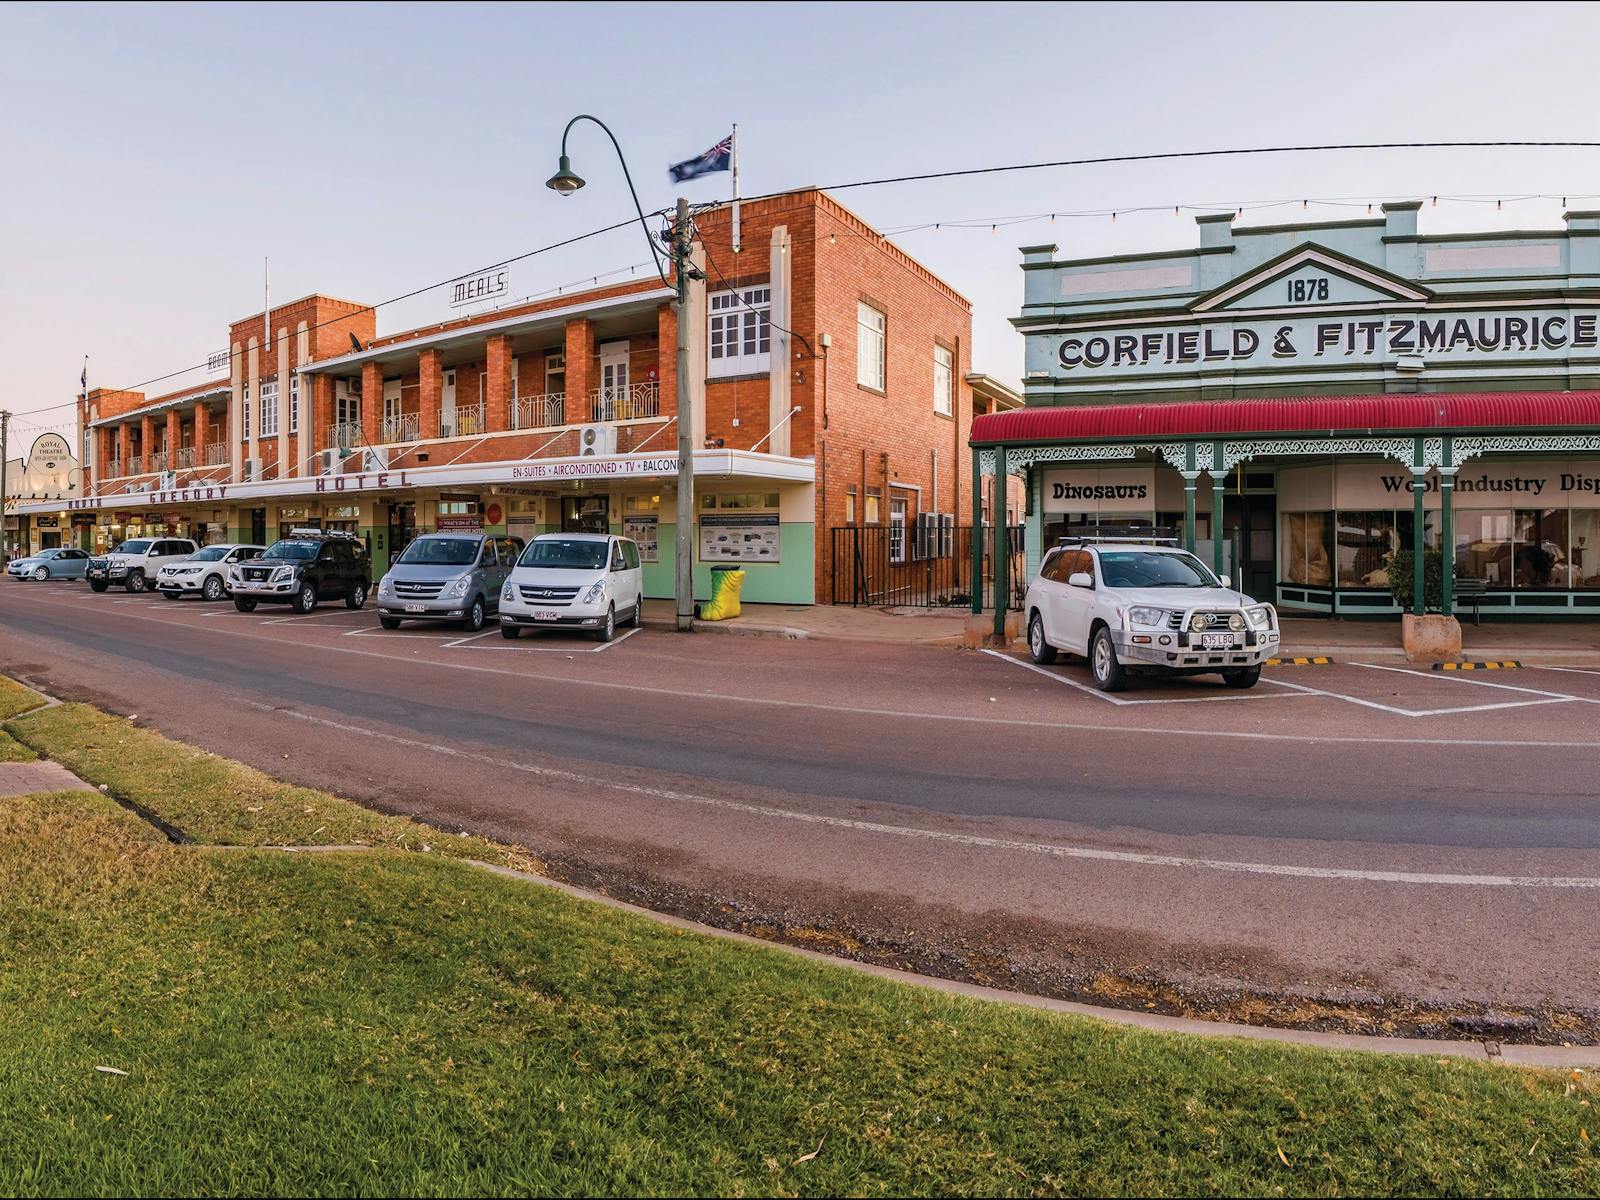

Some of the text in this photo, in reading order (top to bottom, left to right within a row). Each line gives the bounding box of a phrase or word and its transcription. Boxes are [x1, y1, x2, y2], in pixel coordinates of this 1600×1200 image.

[454, 272, 504, 302] MEALS
[1287, 278, 1329, 302] 1878
[1058, 315, 1598, 370] CORFIELD & FITZMAURICE
[208, 352, 230, 369] ROOM
[40, 441, 61, 449] ROYAL
[512, 466, 546, 478] EN-SUITES
[553, 462, 617, 476] AIRCONDITIONED
[625, 461, 635, 472] TV
[150, 486, 227, 504] GREGORY
[316, 471, 412, 492] HOTEL
[1052, 482, 1147, 500] Dinosaurs
[1452, 474, 1546, 495] Industry
